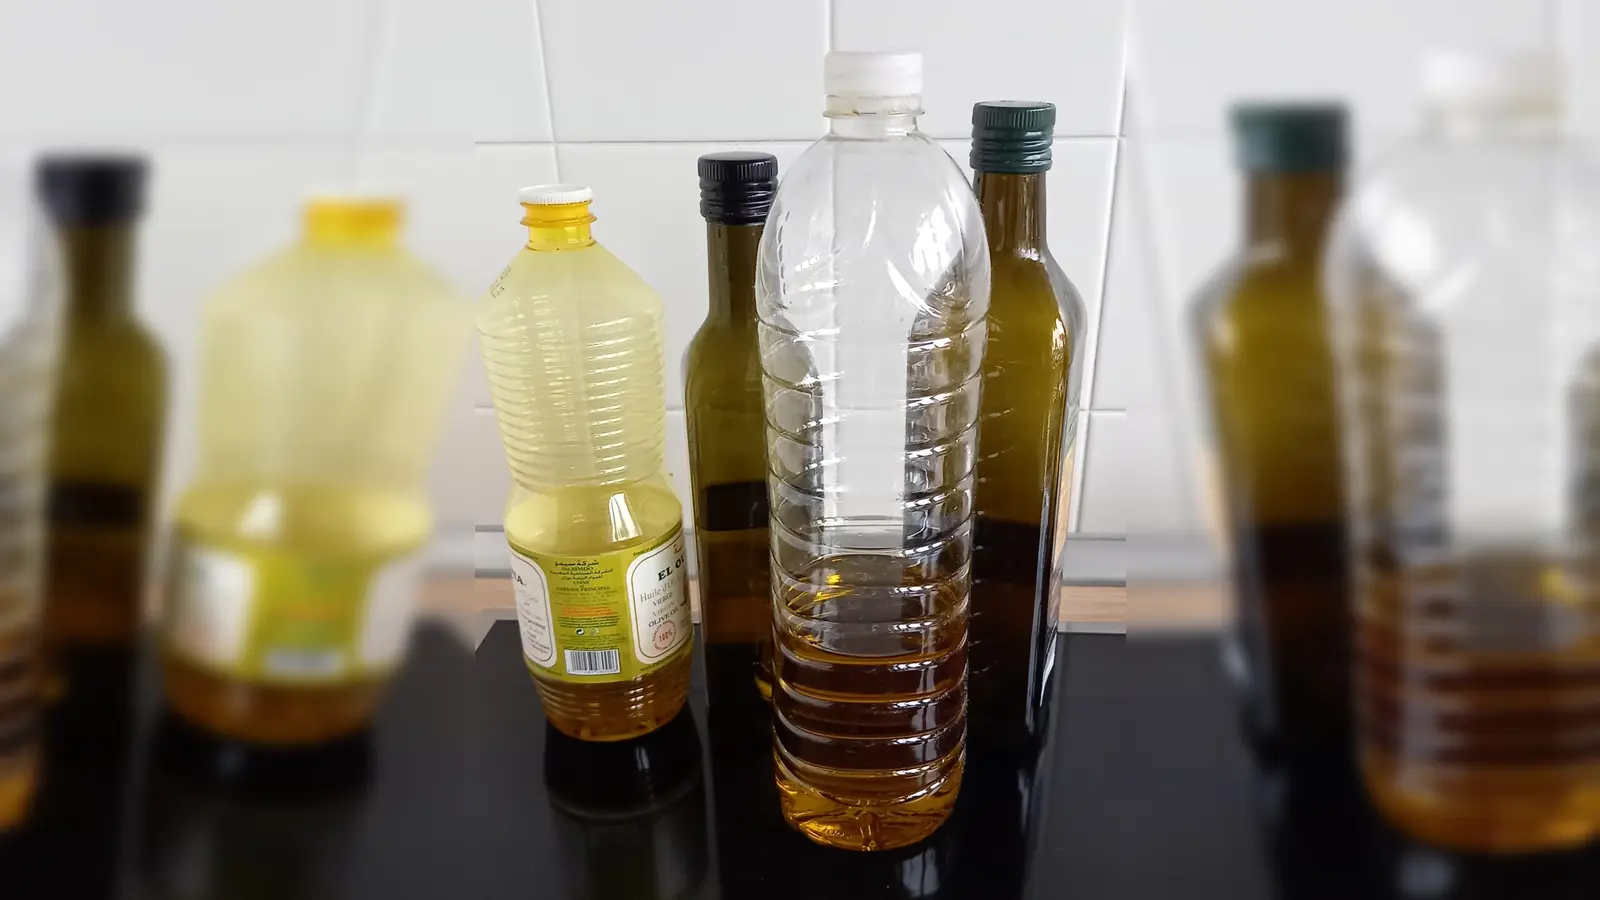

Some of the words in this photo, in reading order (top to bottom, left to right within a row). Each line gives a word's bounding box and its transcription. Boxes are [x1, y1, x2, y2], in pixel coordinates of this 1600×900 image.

[658, 566, 673, 582] EL
[639, 588, 661, 603] Huile
[648, 612, 670, 628] OLIVE
